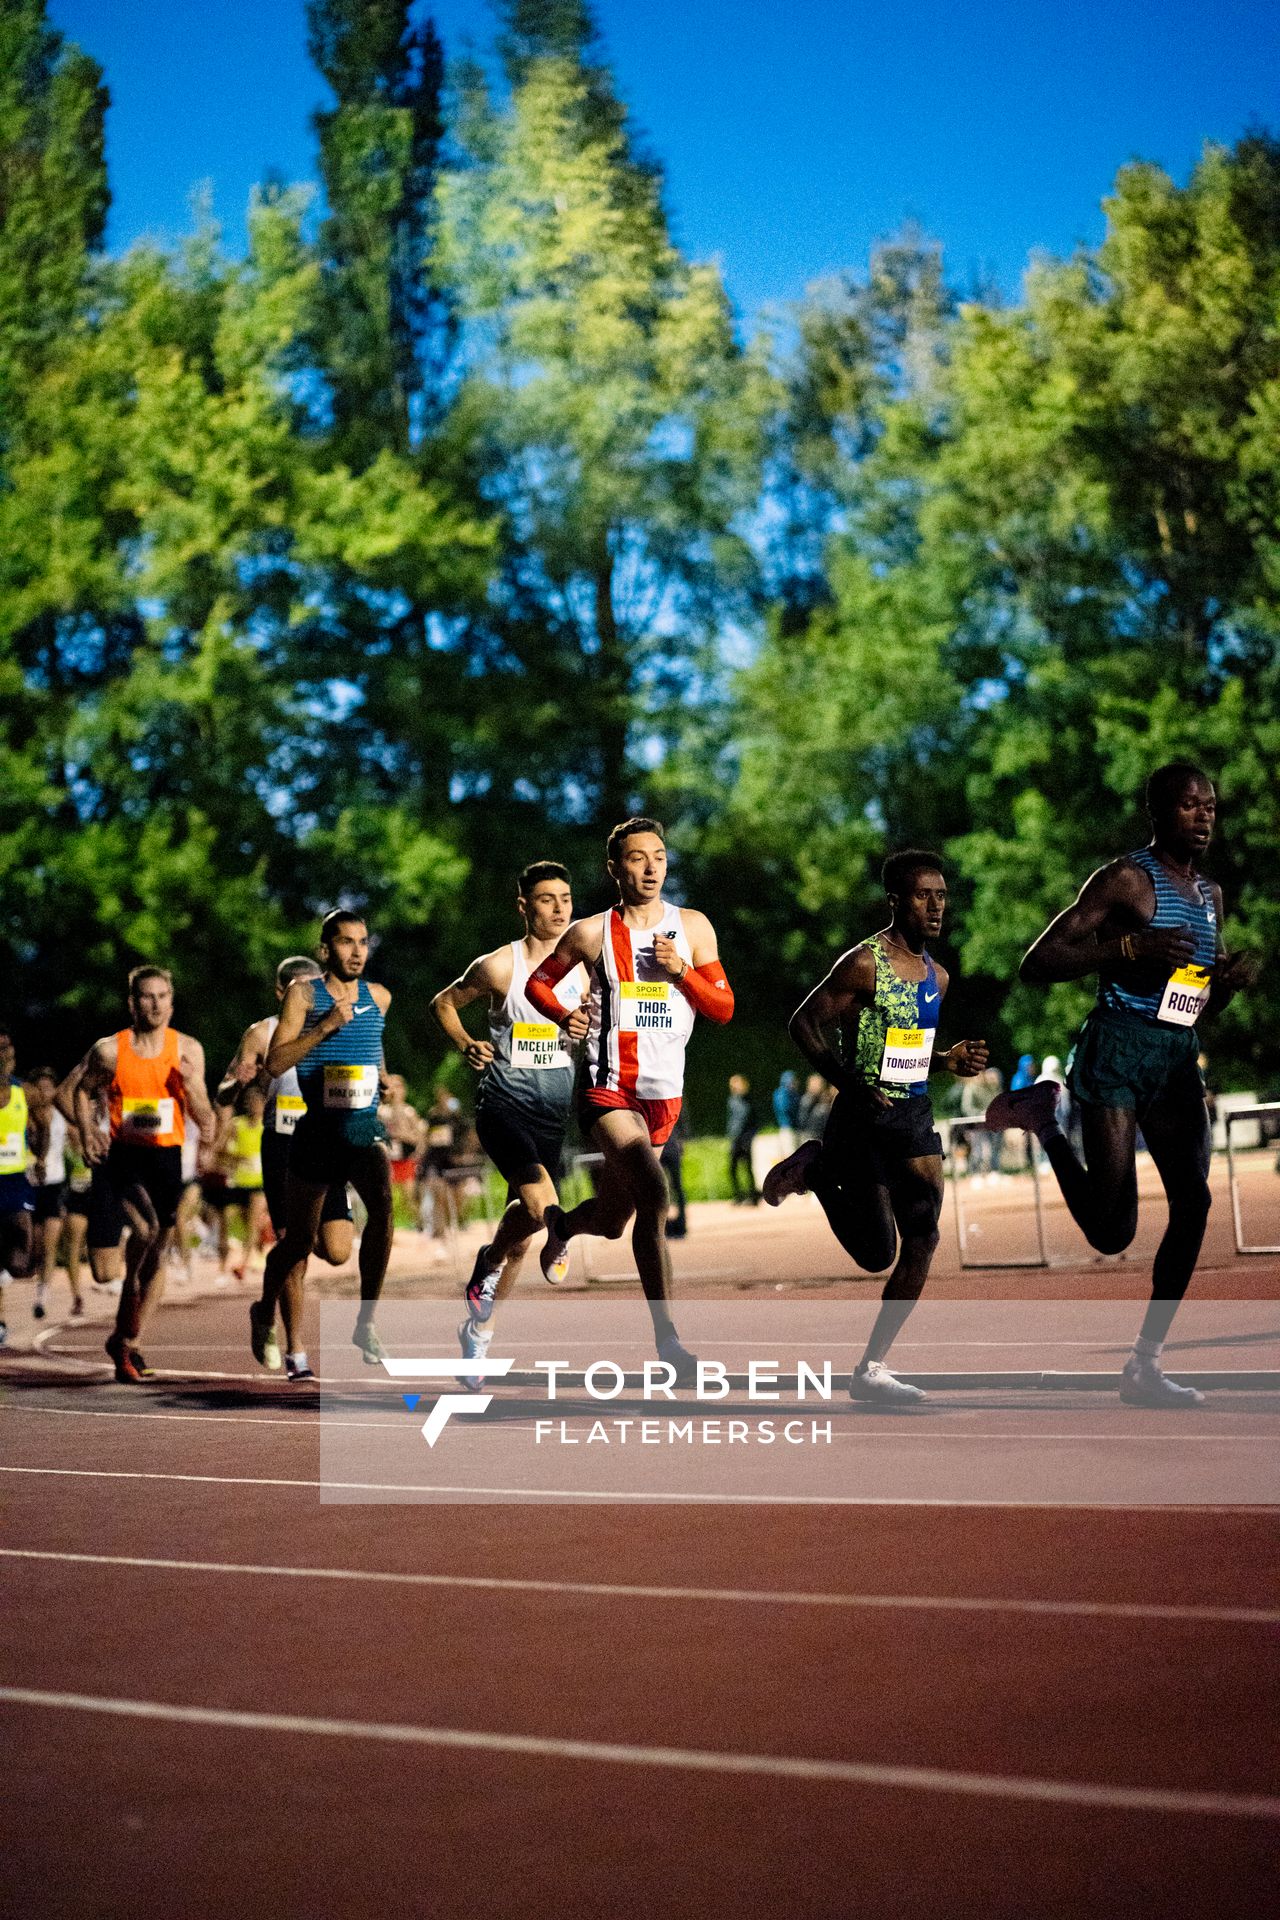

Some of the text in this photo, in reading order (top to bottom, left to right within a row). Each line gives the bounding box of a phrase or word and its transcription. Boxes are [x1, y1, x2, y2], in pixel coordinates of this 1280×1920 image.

[637, 1001, 671, 1014] THOR-
[635, 1015, 672, 1028] WIRTH
[533, 1053, 554, 1064] NEY
[886, 1057, 917, 1069] TONOSA
